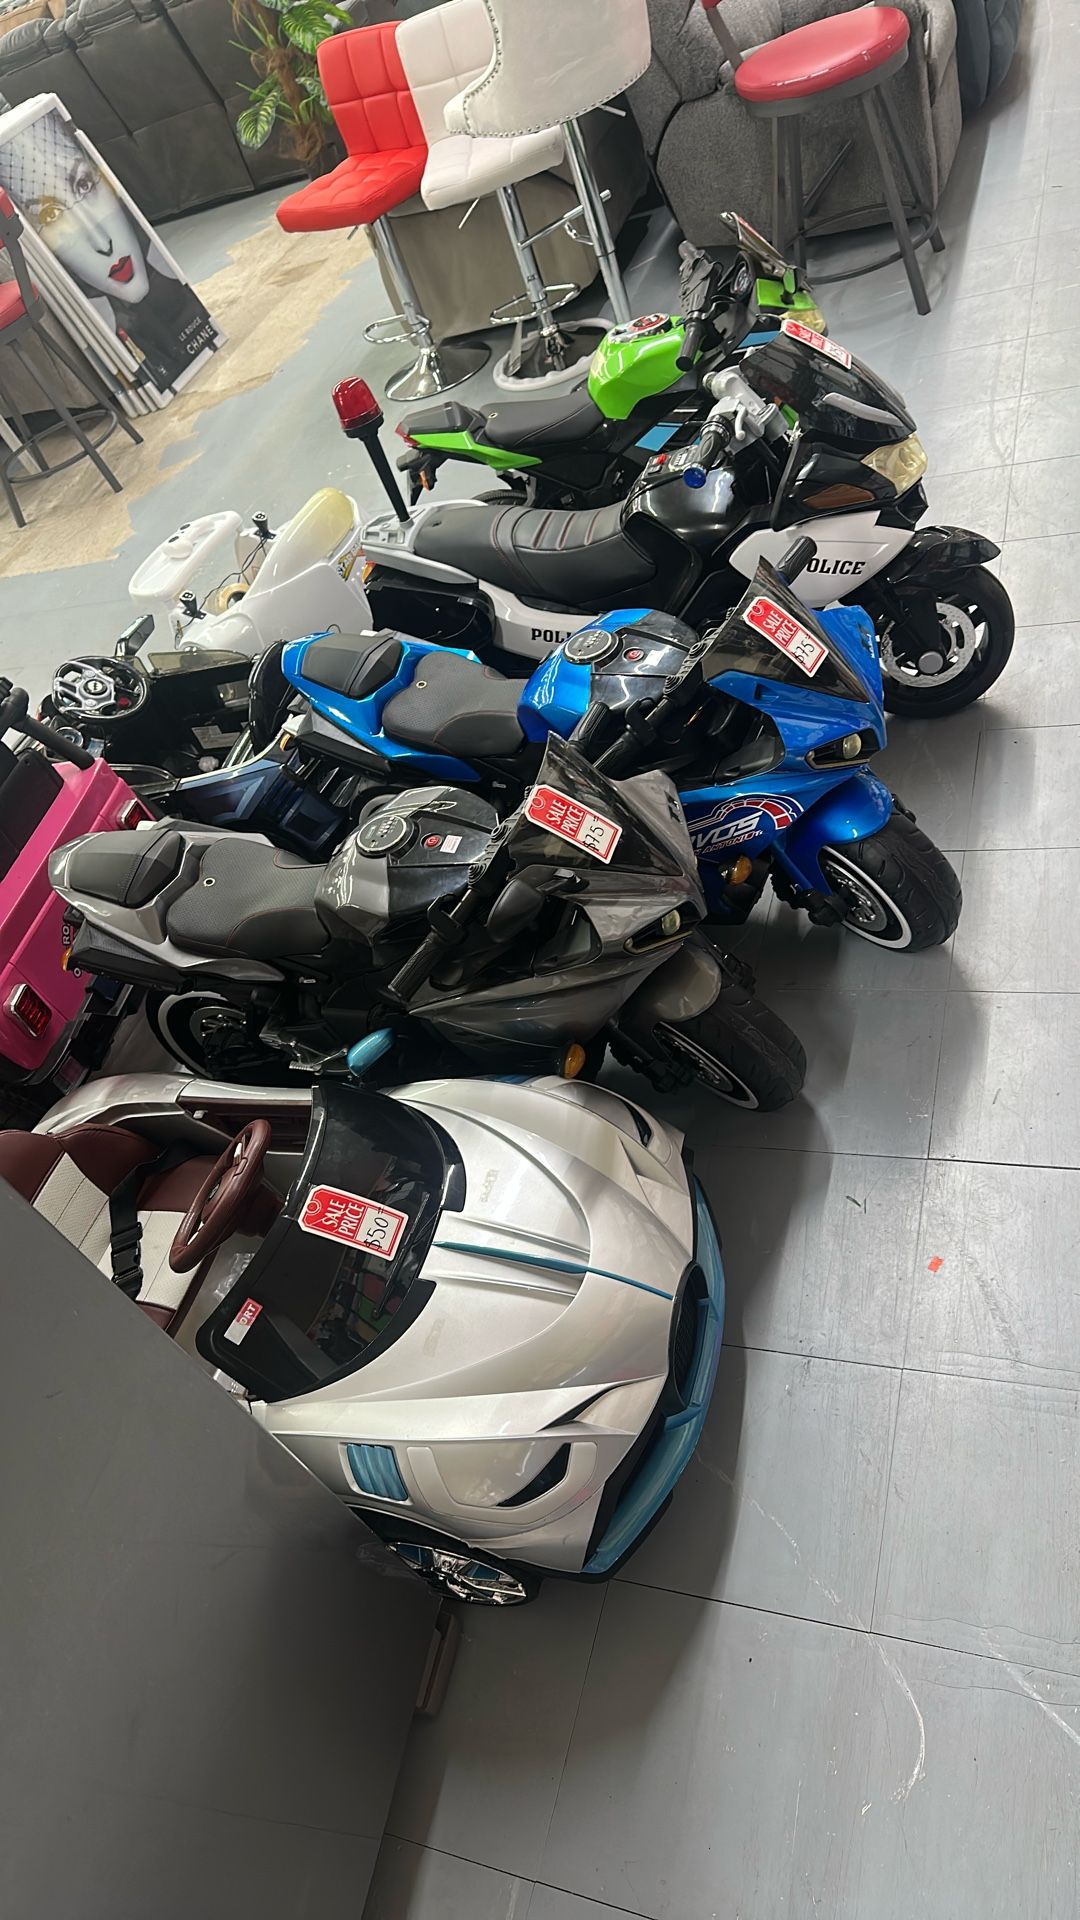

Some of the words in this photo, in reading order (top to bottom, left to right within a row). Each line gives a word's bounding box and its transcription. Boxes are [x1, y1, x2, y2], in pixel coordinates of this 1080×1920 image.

[806, 557, 866, 575] OLICE
[762, 610, 784, 633] SALE
[774, 619, 797, 644] PRICE
[546, 799, 567, 825] SALE
[561, 805, 585, 835] PRICE
[321, 1199, 346, 1228] SALE
[338, 1202, 365, 1237] PRICE
